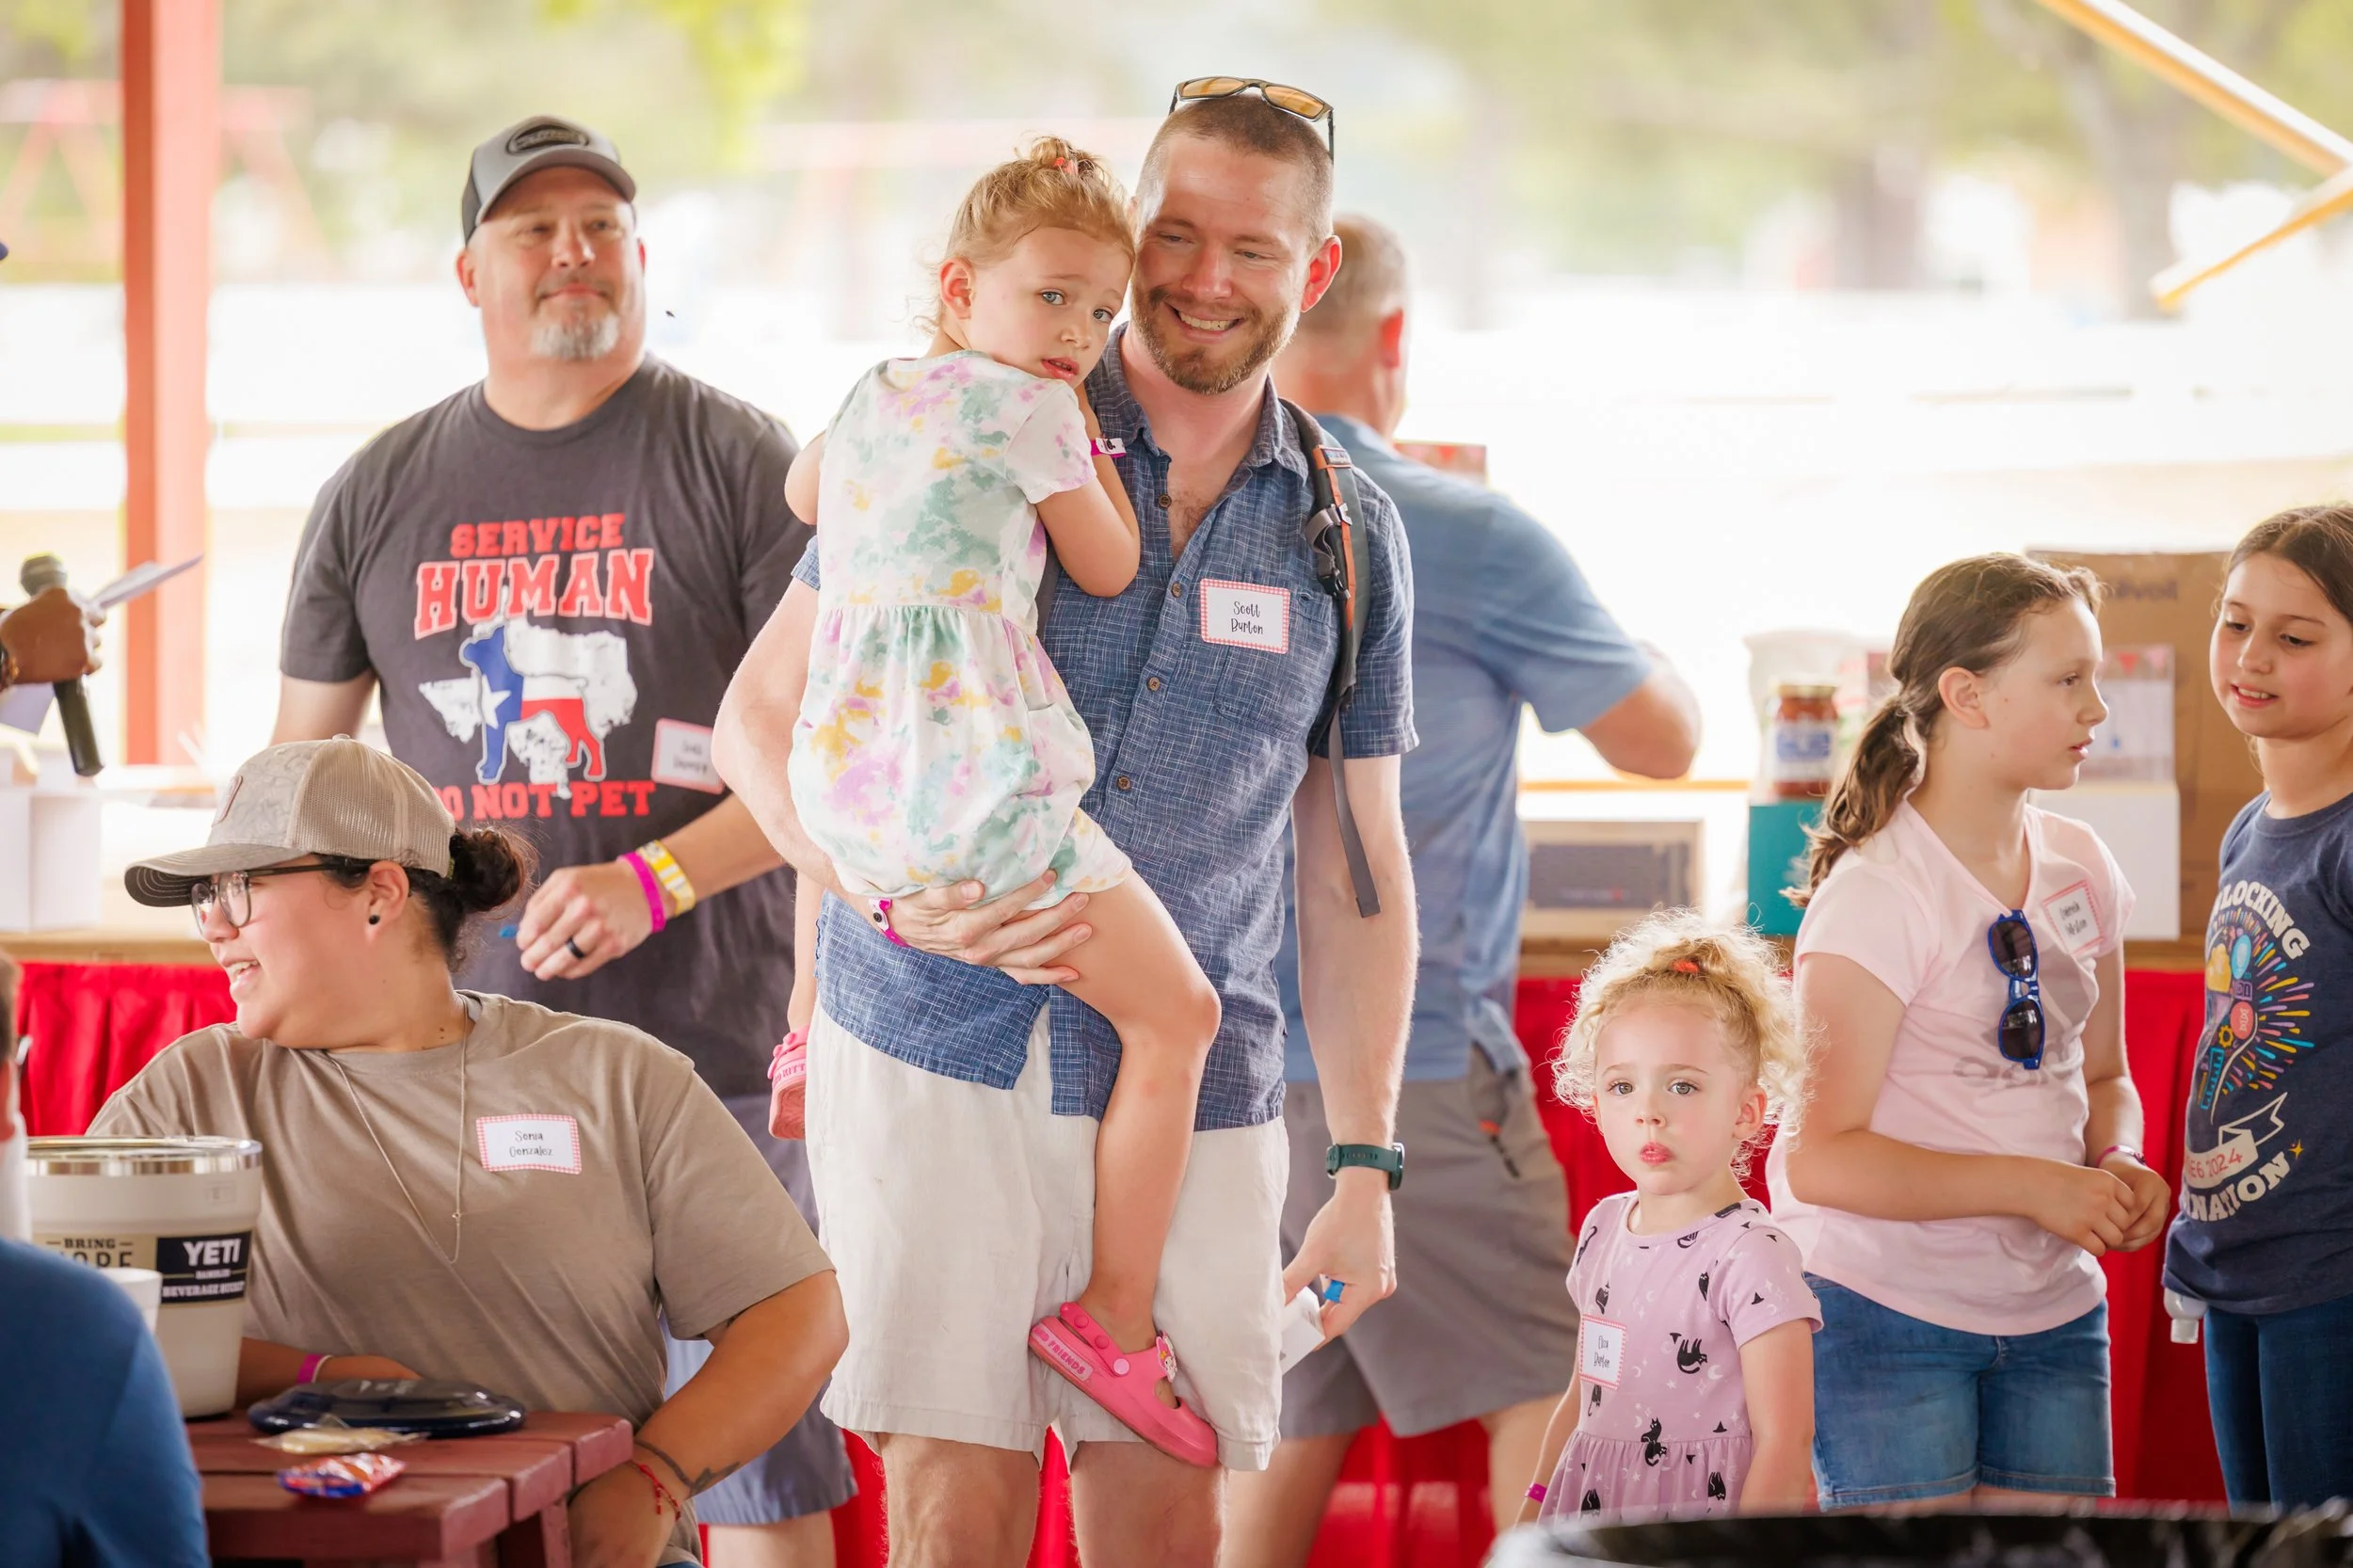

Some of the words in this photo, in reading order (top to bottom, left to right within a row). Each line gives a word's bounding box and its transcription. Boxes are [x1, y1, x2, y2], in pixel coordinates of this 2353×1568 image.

[450, 513, 625, 558] SERVICE
[414, 548, 654, 640] HUMAN
[1233, 600, 1260, 617] Scott
[1230, 617, 1263, 634] Burton
[434, 784, 464, 821] O
[471, 780, 558, 820] NOT
[569, 780, 656, 817] PET
[515, 1129, 543, 1142] Sonia
[509, 1145, 553, 1158] Gonzalez
[2207, 1147, 2243, 1177] 2024
[64, 1238, 116, 1250] BRING
[183, 1238, 241, 1267] YETI
[1048, 1339, 1086, 1375] FRIENDS
